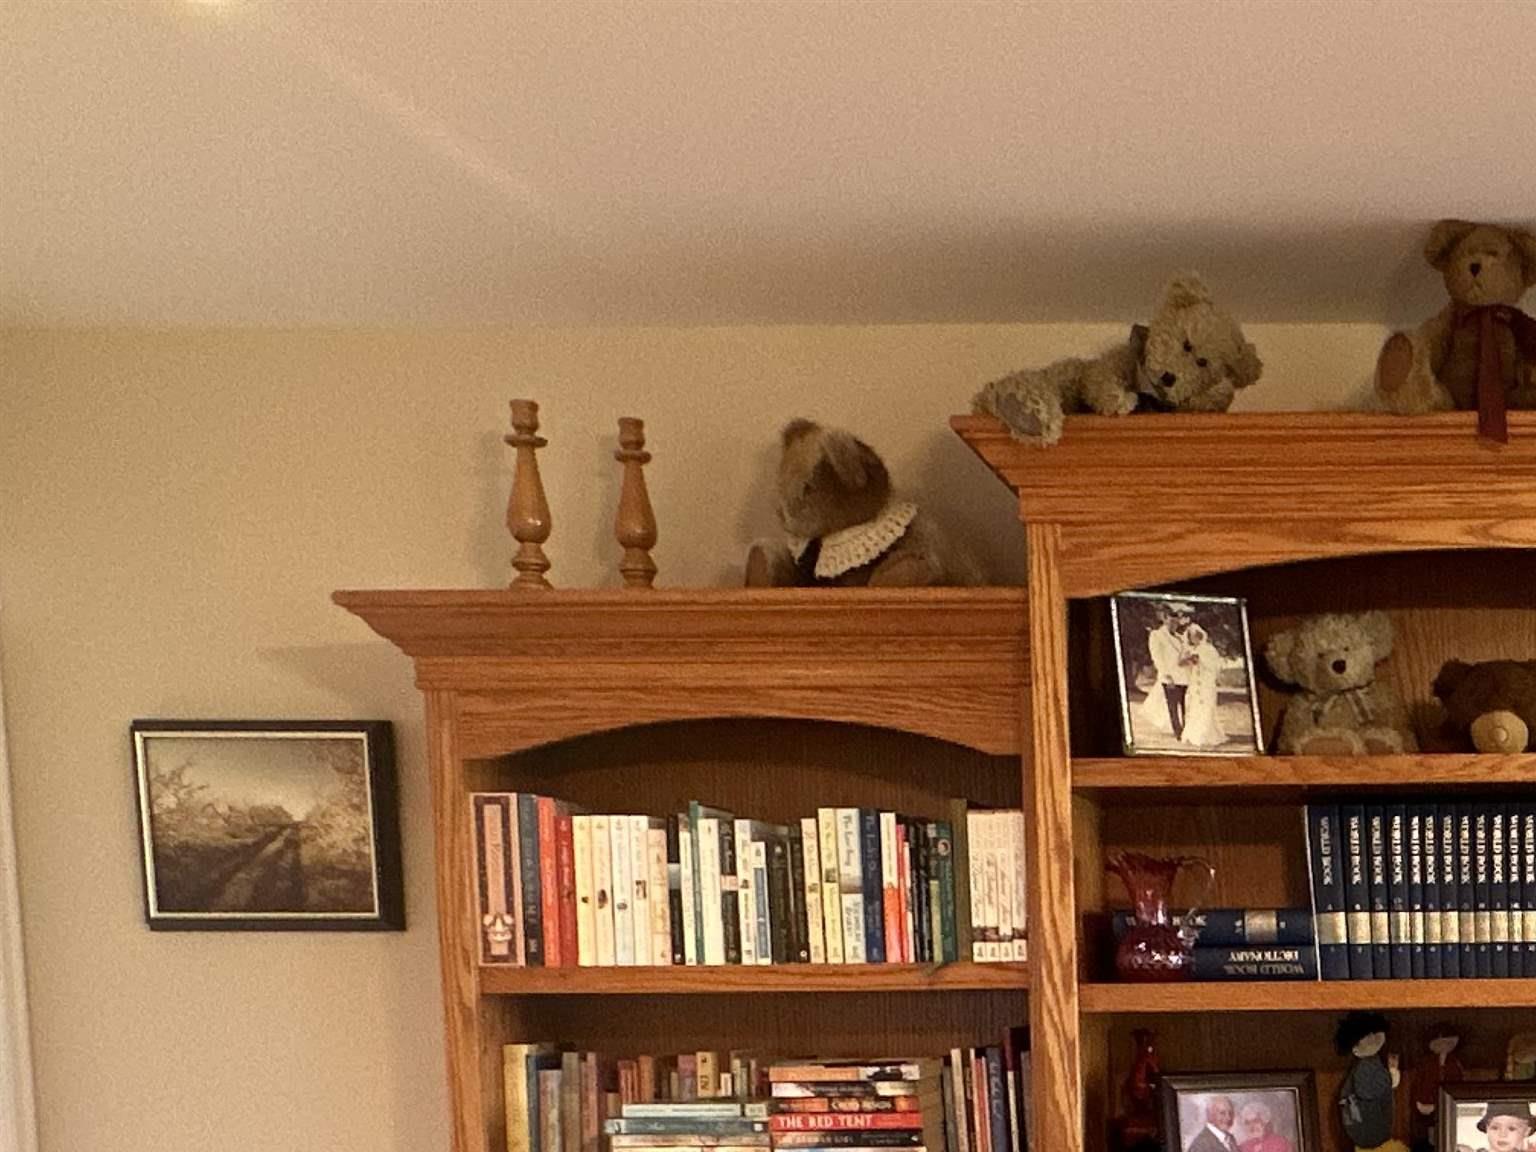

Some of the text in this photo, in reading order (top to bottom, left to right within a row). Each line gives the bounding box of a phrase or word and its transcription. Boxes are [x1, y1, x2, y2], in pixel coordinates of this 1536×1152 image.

[1228, 950, 1299, 962] DICTIONARY
[779, 1114, 873, 1128] THE RED TENT
